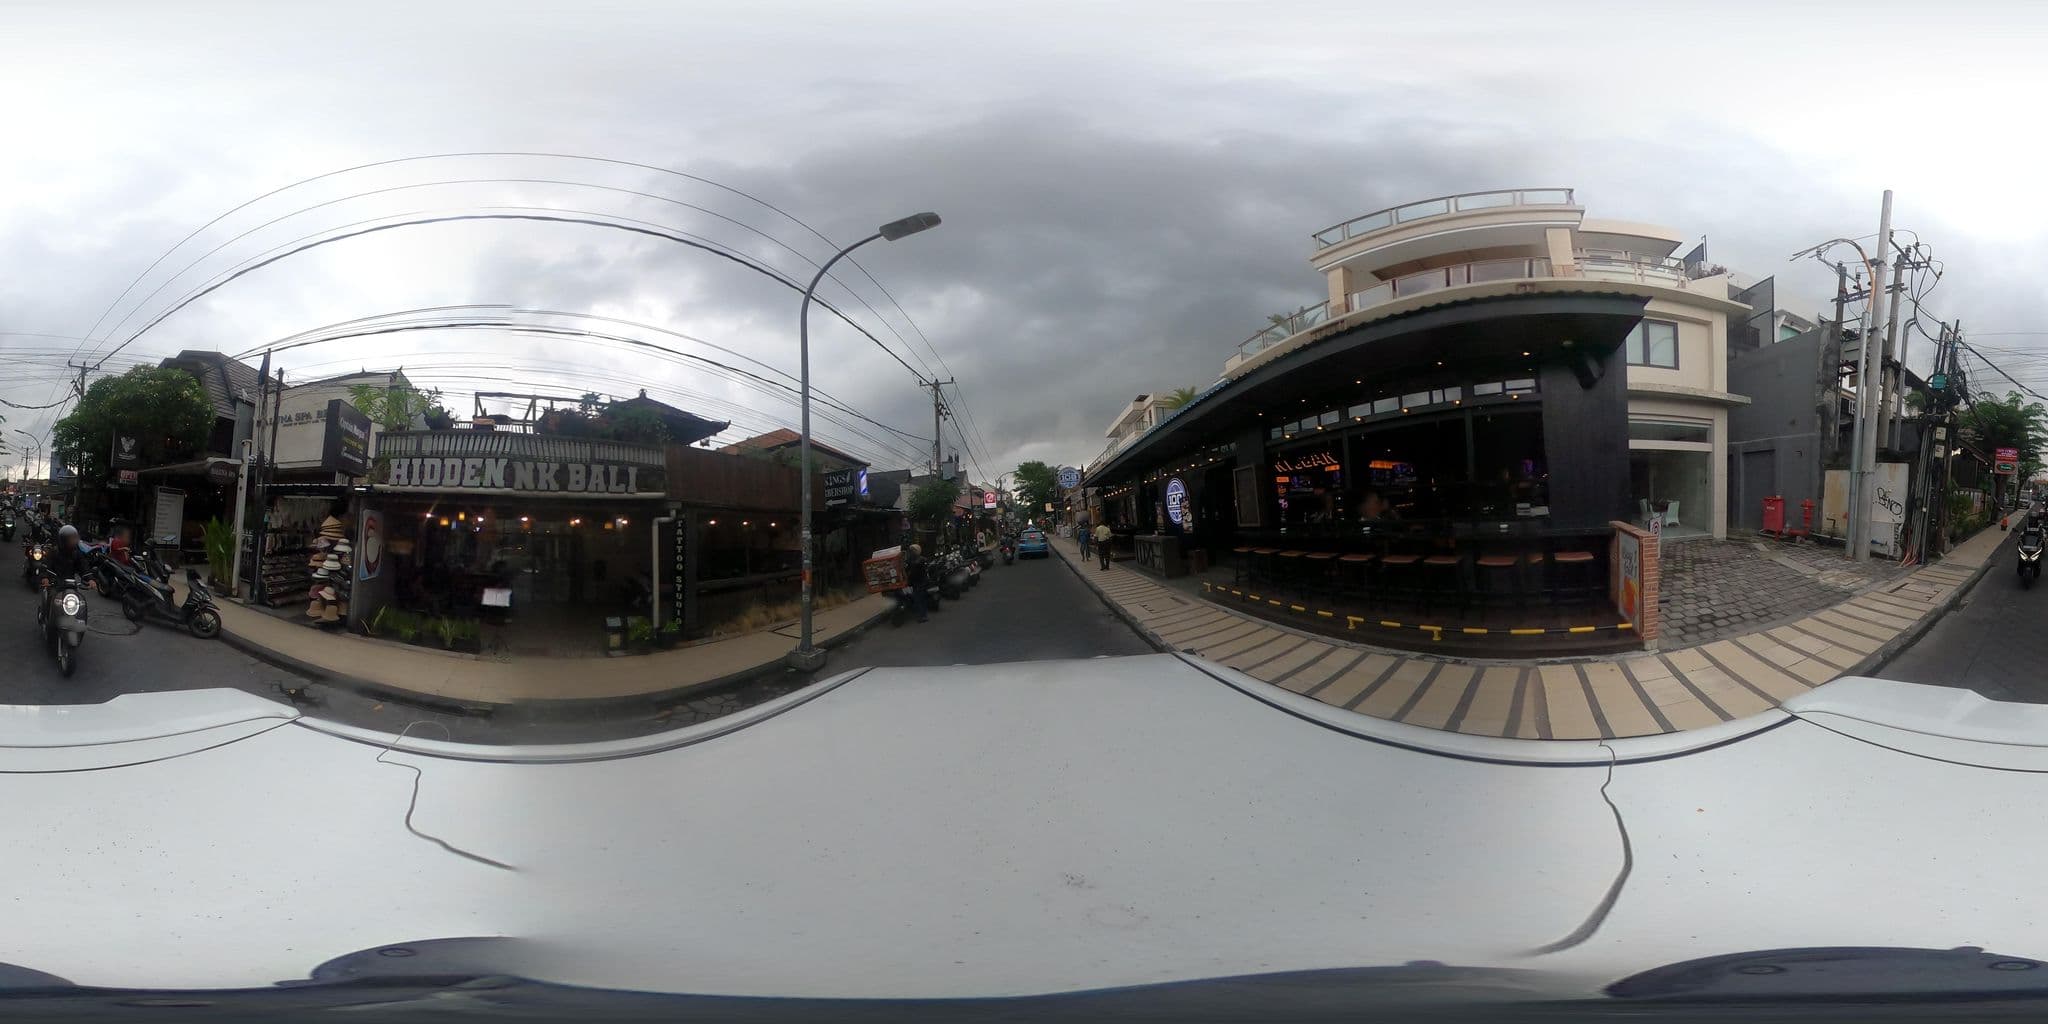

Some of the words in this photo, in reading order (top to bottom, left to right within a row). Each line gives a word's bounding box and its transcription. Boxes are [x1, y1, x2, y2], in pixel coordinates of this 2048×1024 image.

[389, 457, 508, 487] HIDDEN
[513, 461, 560, 491] NK
[567, 463, 637, 493] BALI
[675, 519, 684, 571] TATTOO
[675, 576, 683, 625] STUDIO
